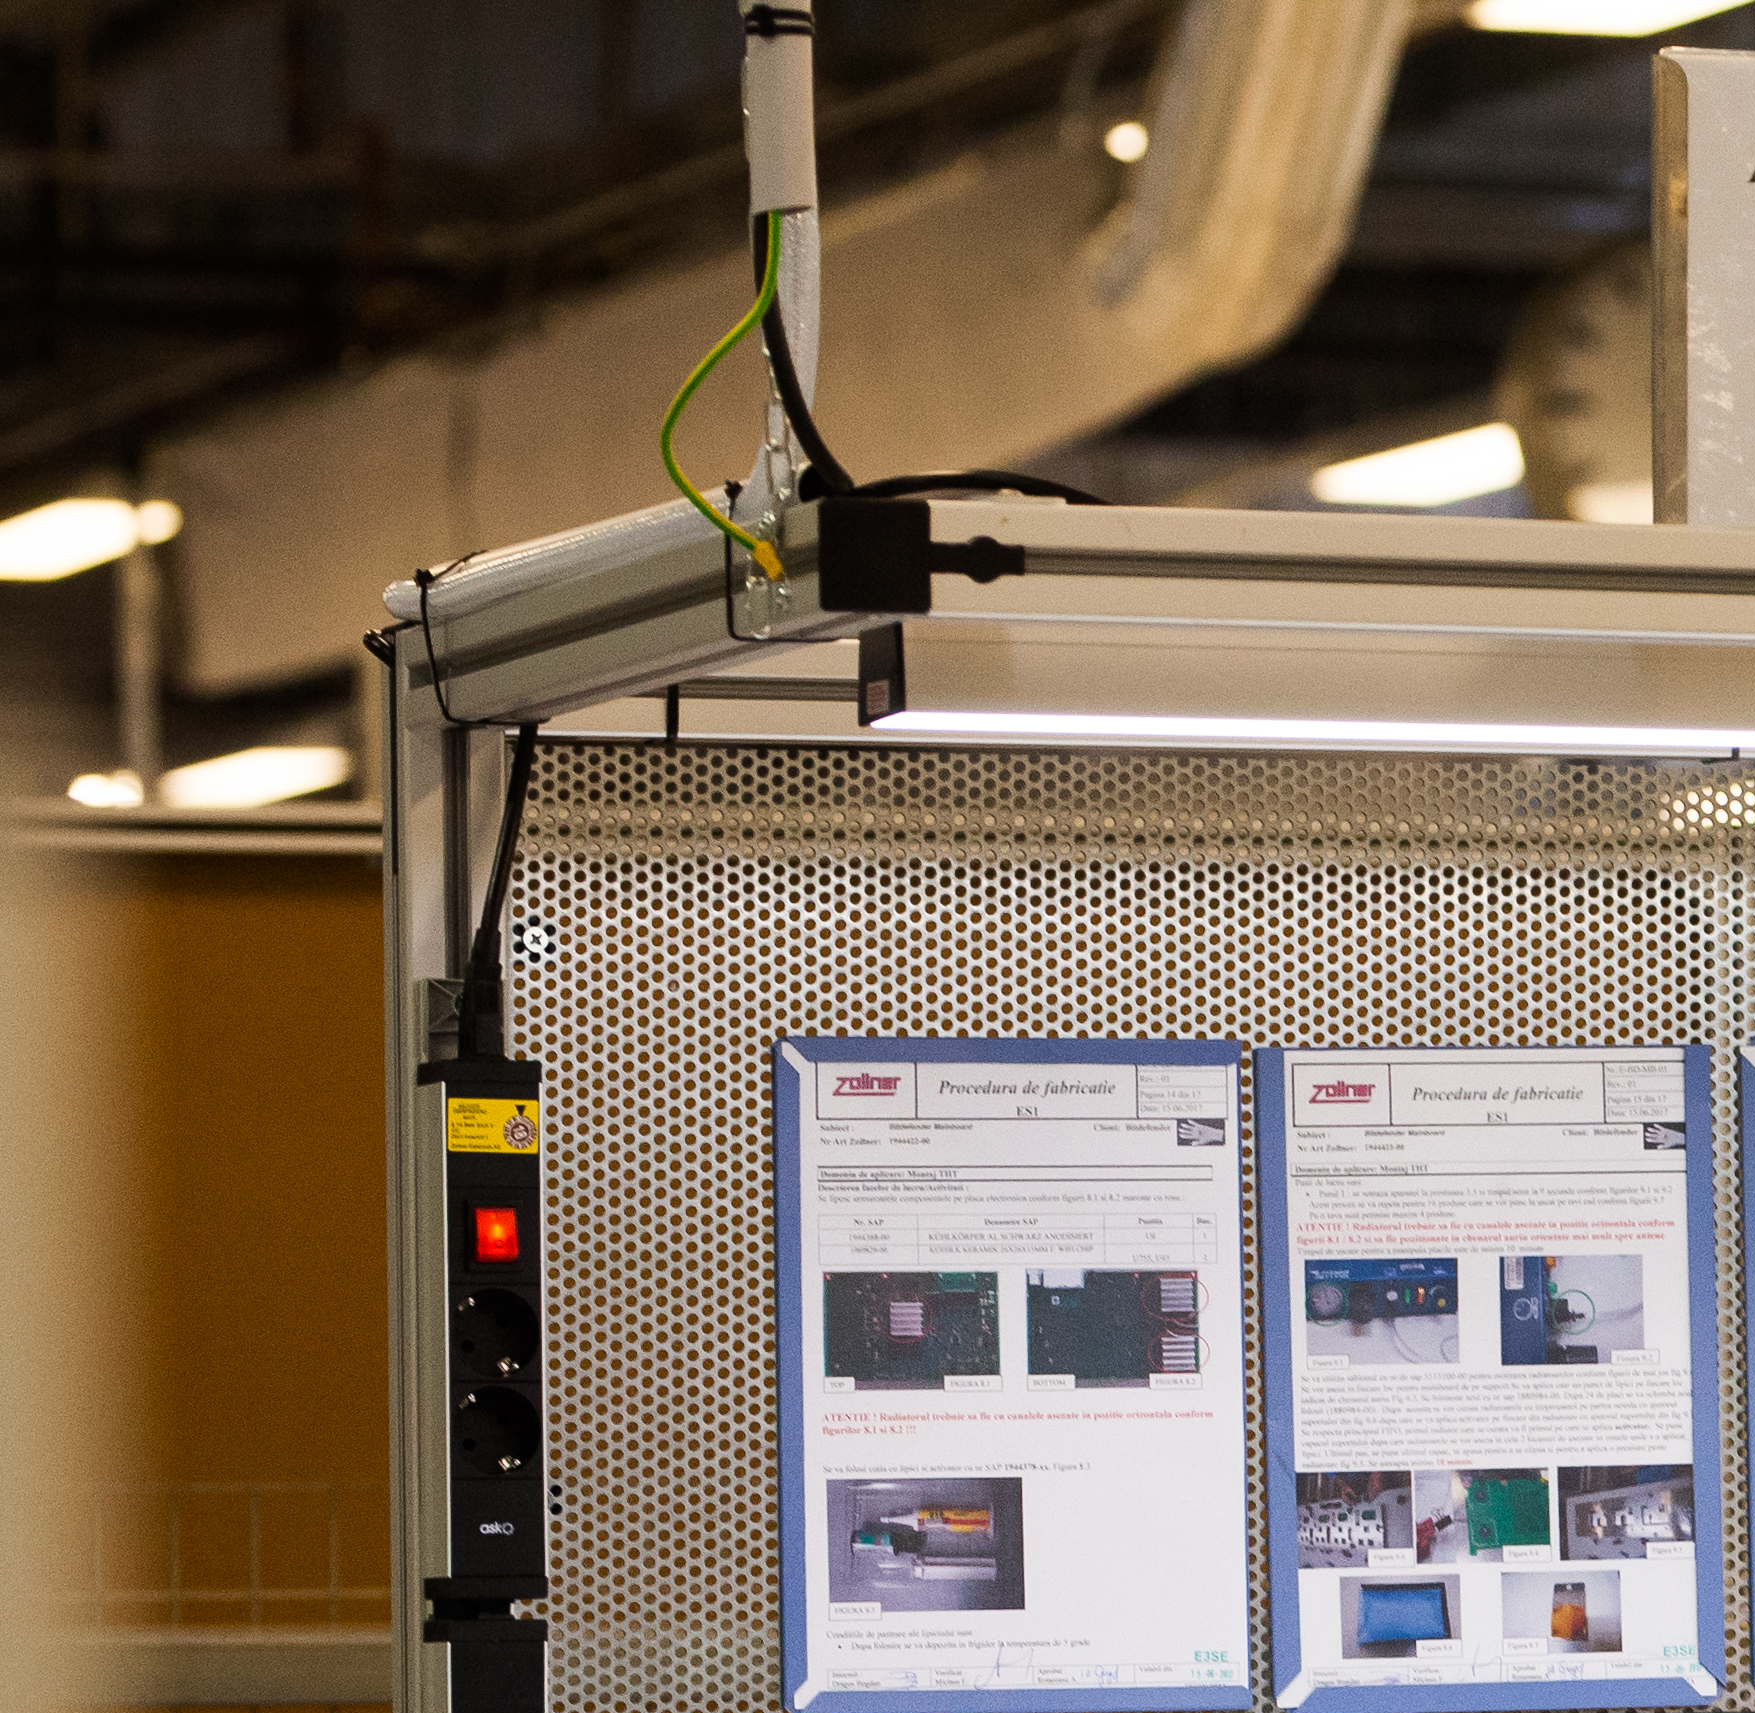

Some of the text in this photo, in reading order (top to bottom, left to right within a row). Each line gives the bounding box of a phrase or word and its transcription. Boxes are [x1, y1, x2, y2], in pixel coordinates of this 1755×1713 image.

[938, 1081, 1116, 1095] Procedura de fabricatie
[1412, 1088, 1584, 1101] Procedura de fabricatie
